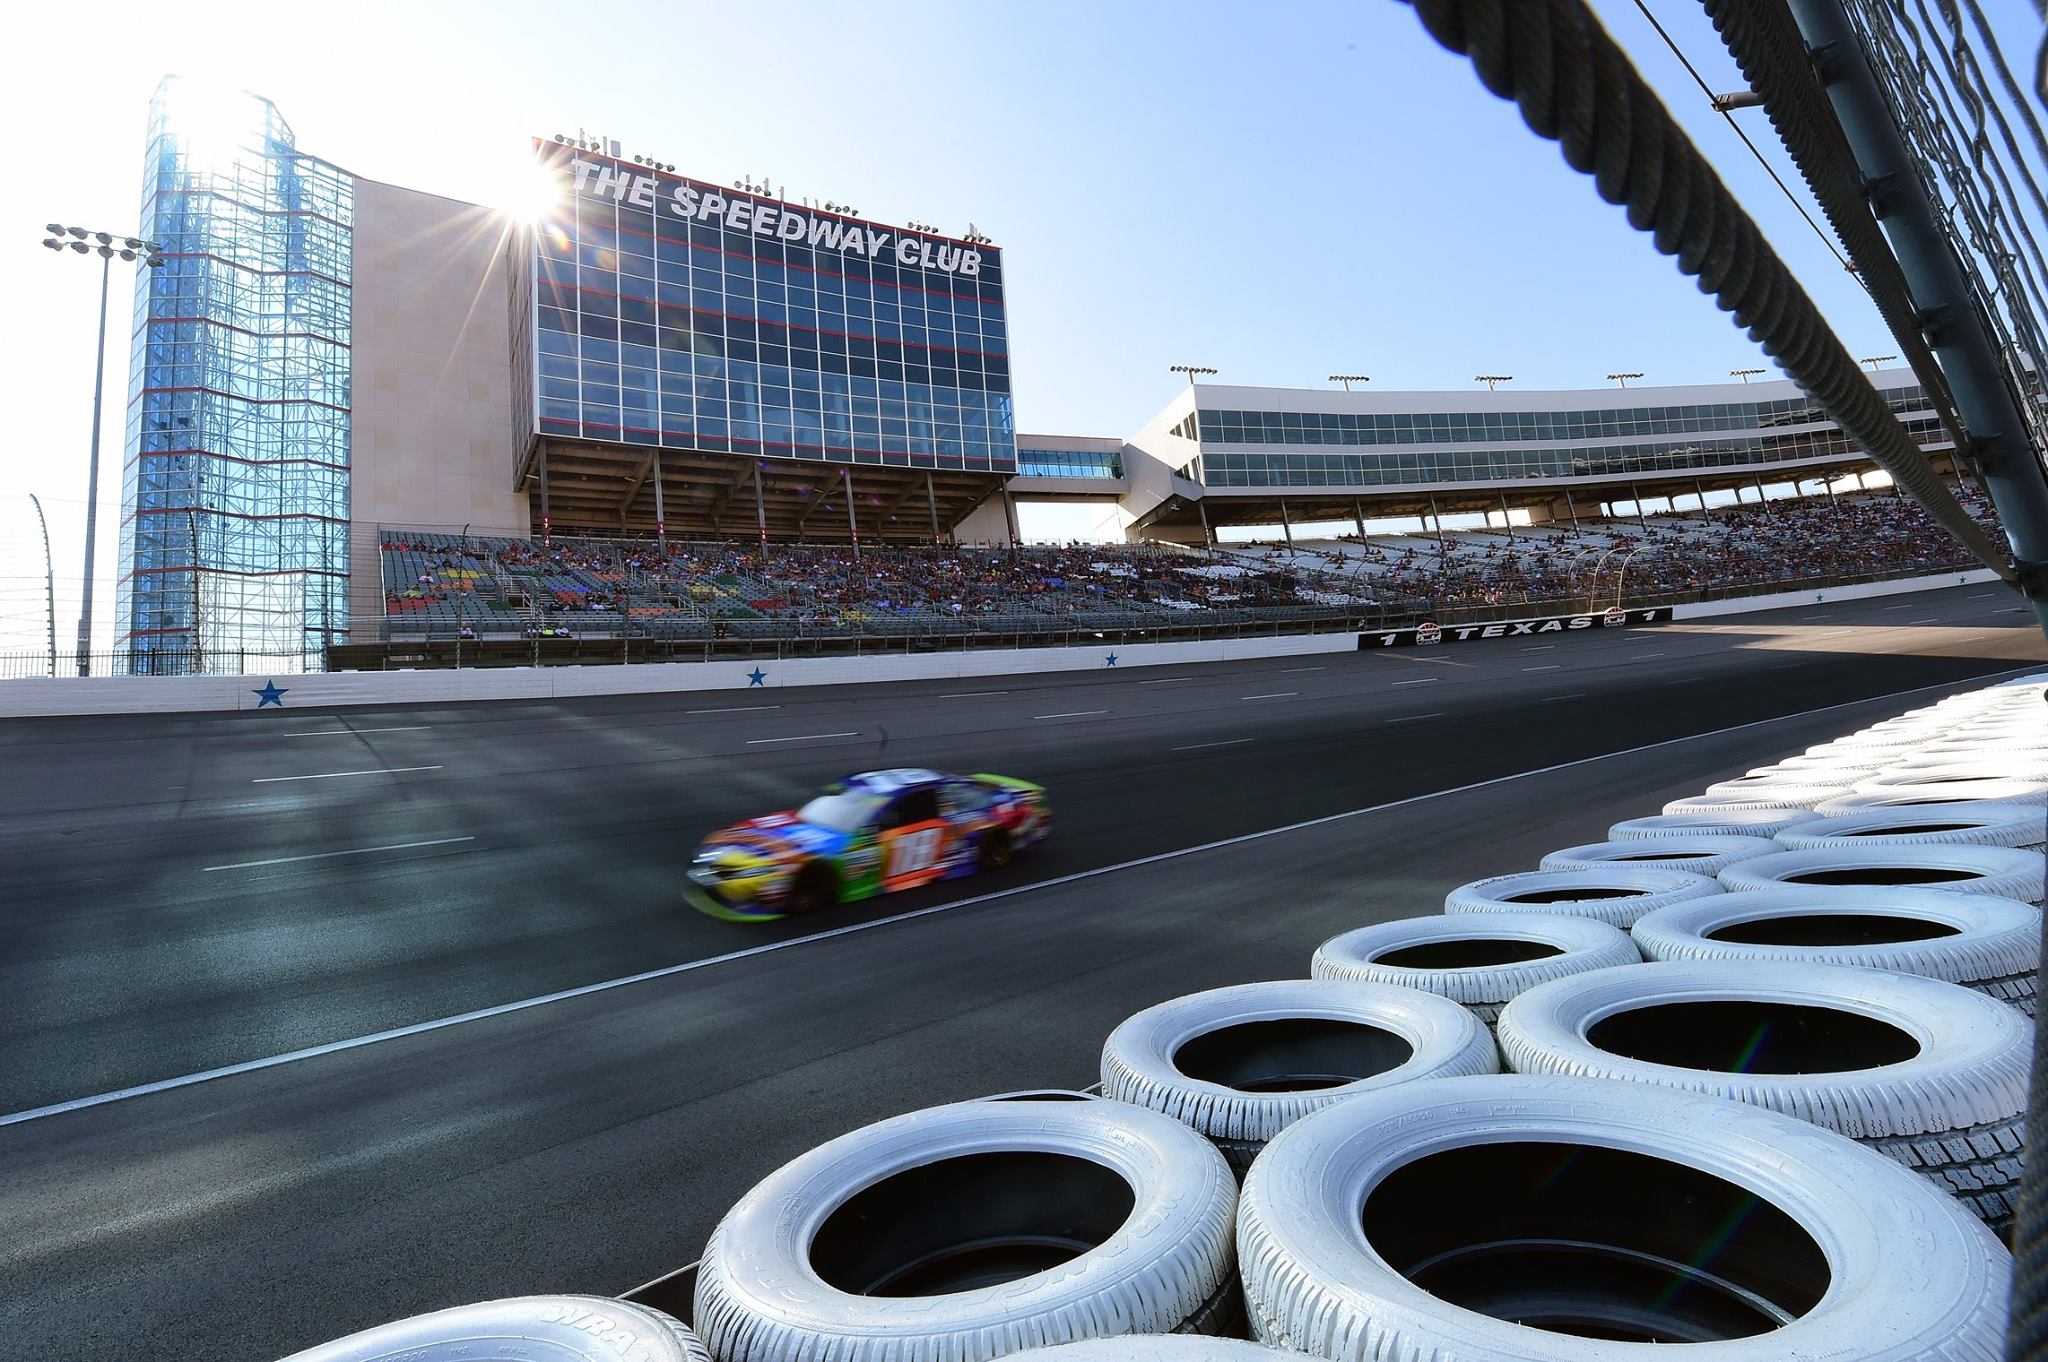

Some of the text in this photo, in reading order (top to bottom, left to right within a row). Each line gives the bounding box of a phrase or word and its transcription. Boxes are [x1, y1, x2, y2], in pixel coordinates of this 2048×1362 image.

[571, 158, 982, 275] THE SPEEDWAY CLUB
[1380, 610, 1657, 646] 1 TEXAS 1
